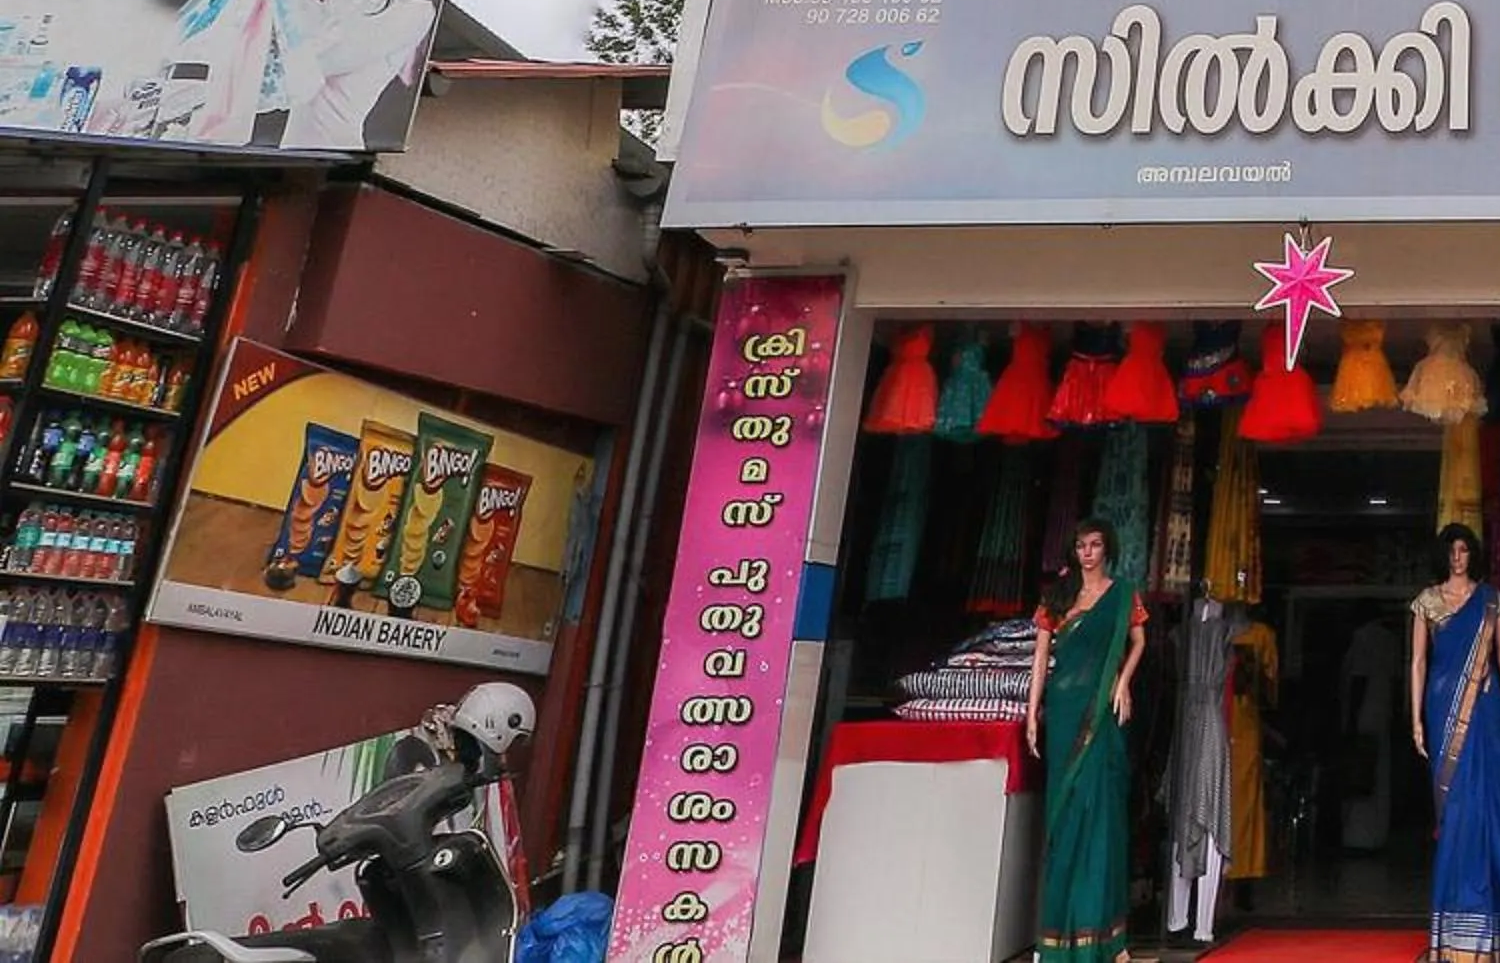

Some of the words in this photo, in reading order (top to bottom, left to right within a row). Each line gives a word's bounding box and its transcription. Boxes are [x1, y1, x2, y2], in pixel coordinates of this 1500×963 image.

[807, 8, 829, 24] 90
[836, 8, 869, 23] 728
[876, 8, 910, 23] 006
[916, 7, 940, 23] 62
[1001, 0, 1470, 136] സിൽക്കി
[1137, 162, 1291, 185] അമ്പലവയൽ
[232, 362, 276, 401] NEW
[426, 448, 478, 485] BINGO!
[480, 487, 521, 517] BINGO!
[313, 610, 375, 641] INDIAN
[378, 622, 447, 651] BAKERY
